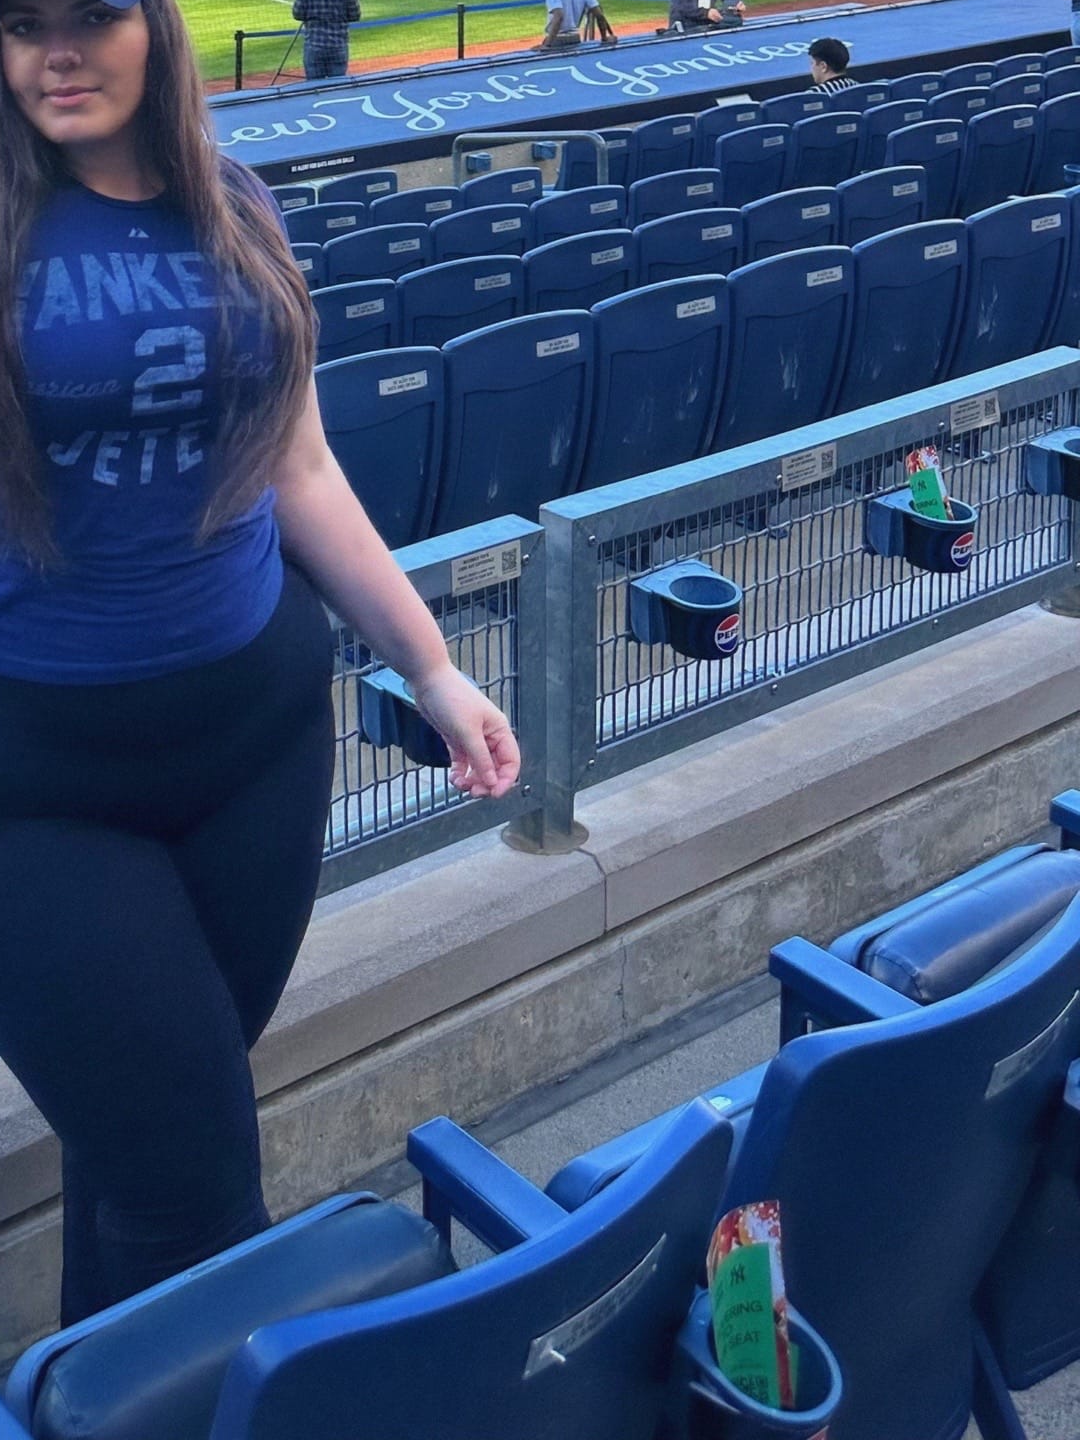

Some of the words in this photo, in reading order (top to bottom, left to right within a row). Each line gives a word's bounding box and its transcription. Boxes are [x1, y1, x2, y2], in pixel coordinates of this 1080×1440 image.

[214, 97, 338, 149] ew
[361, 74, 557, 133] York
[131, 325, 206, 417] 2
[46, 419, 210, 487] JETE
